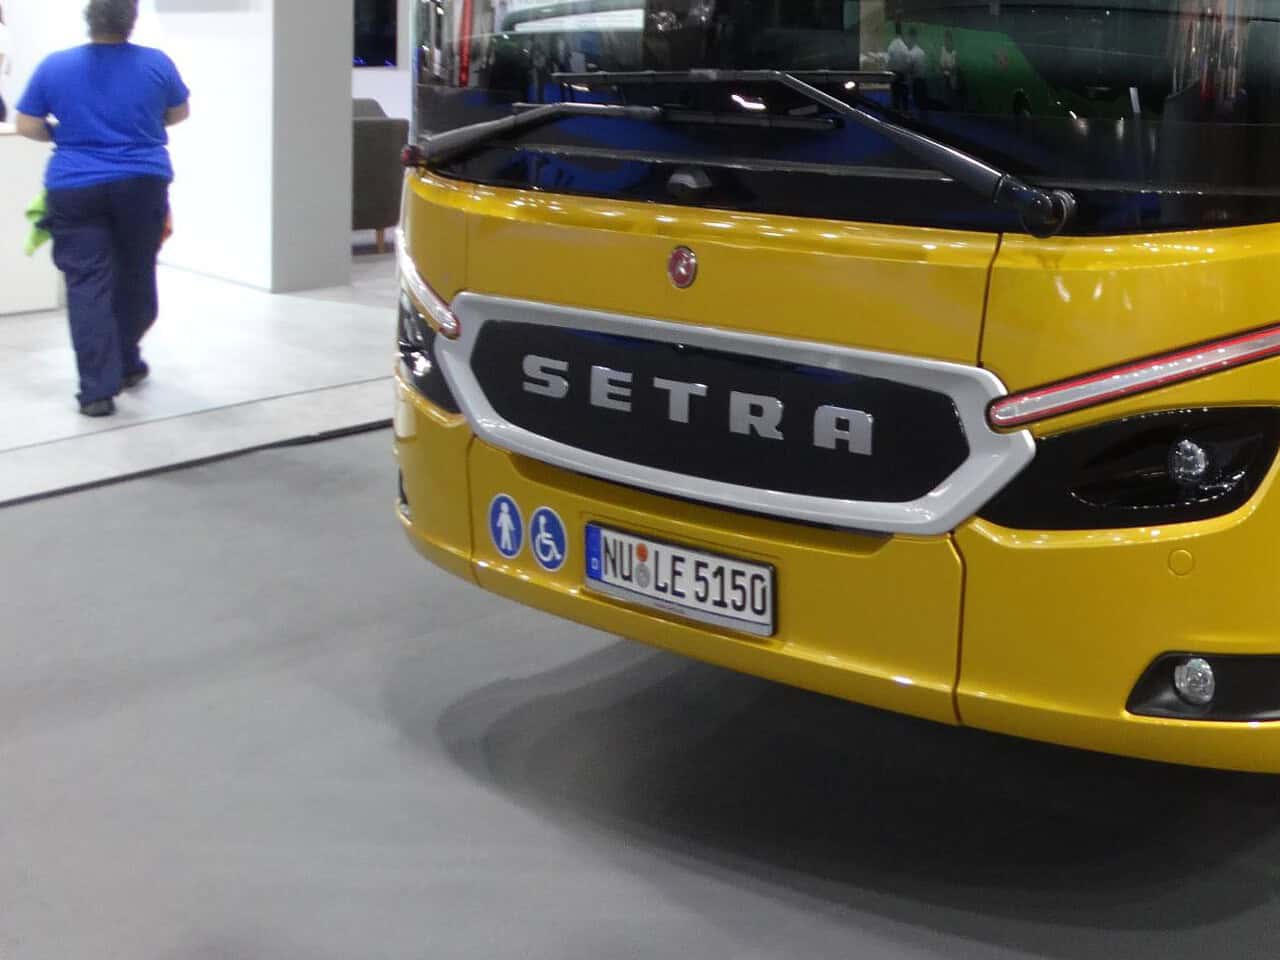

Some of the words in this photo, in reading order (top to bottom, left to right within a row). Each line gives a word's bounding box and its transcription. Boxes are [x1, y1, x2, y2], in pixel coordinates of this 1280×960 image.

[521, 352, 875, 457] SETRA
[604, 536, 633, 582] NU
[654, 550, 686, 598] LE
[694, 560, 768, 616] 5150
